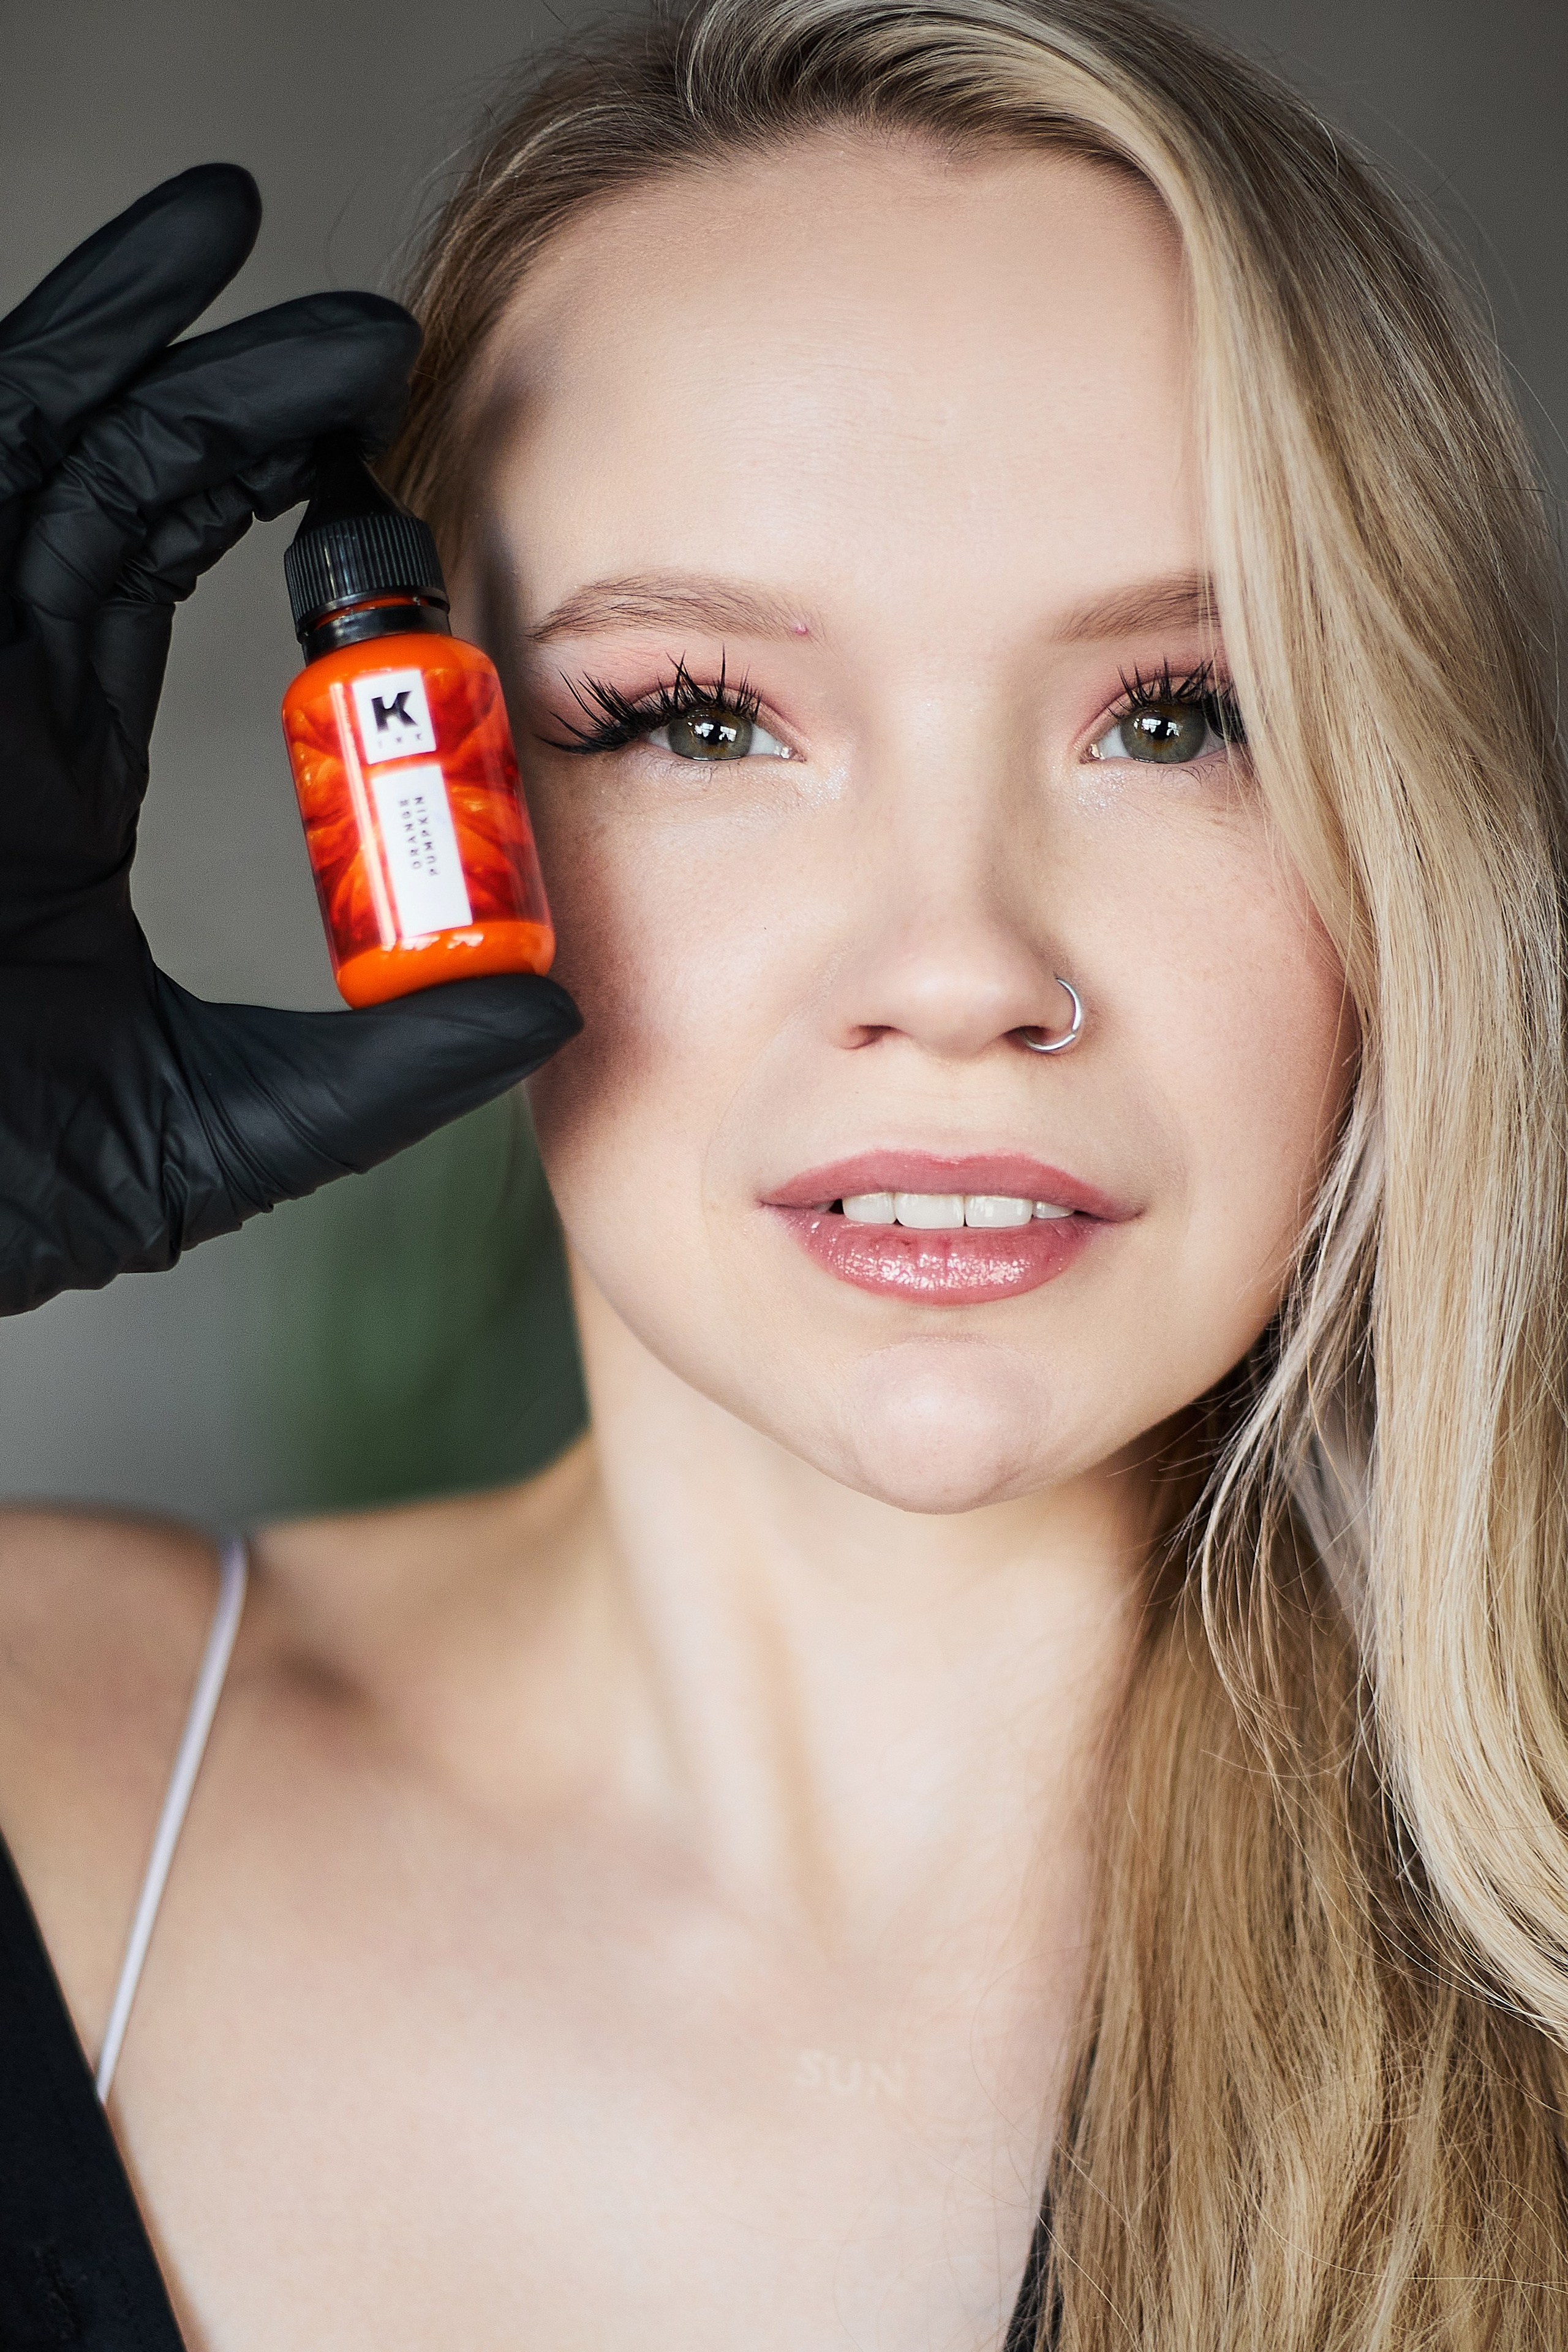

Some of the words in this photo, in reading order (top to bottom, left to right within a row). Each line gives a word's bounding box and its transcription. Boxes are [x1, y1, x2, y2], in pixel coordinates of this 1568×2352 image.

[371, 691, 418, 732] K
[399, 799, 422, 869] ORANGE
[415, 796, 439, 876] PUMPKIN
[797, 2049, 903, 2101] SUN
